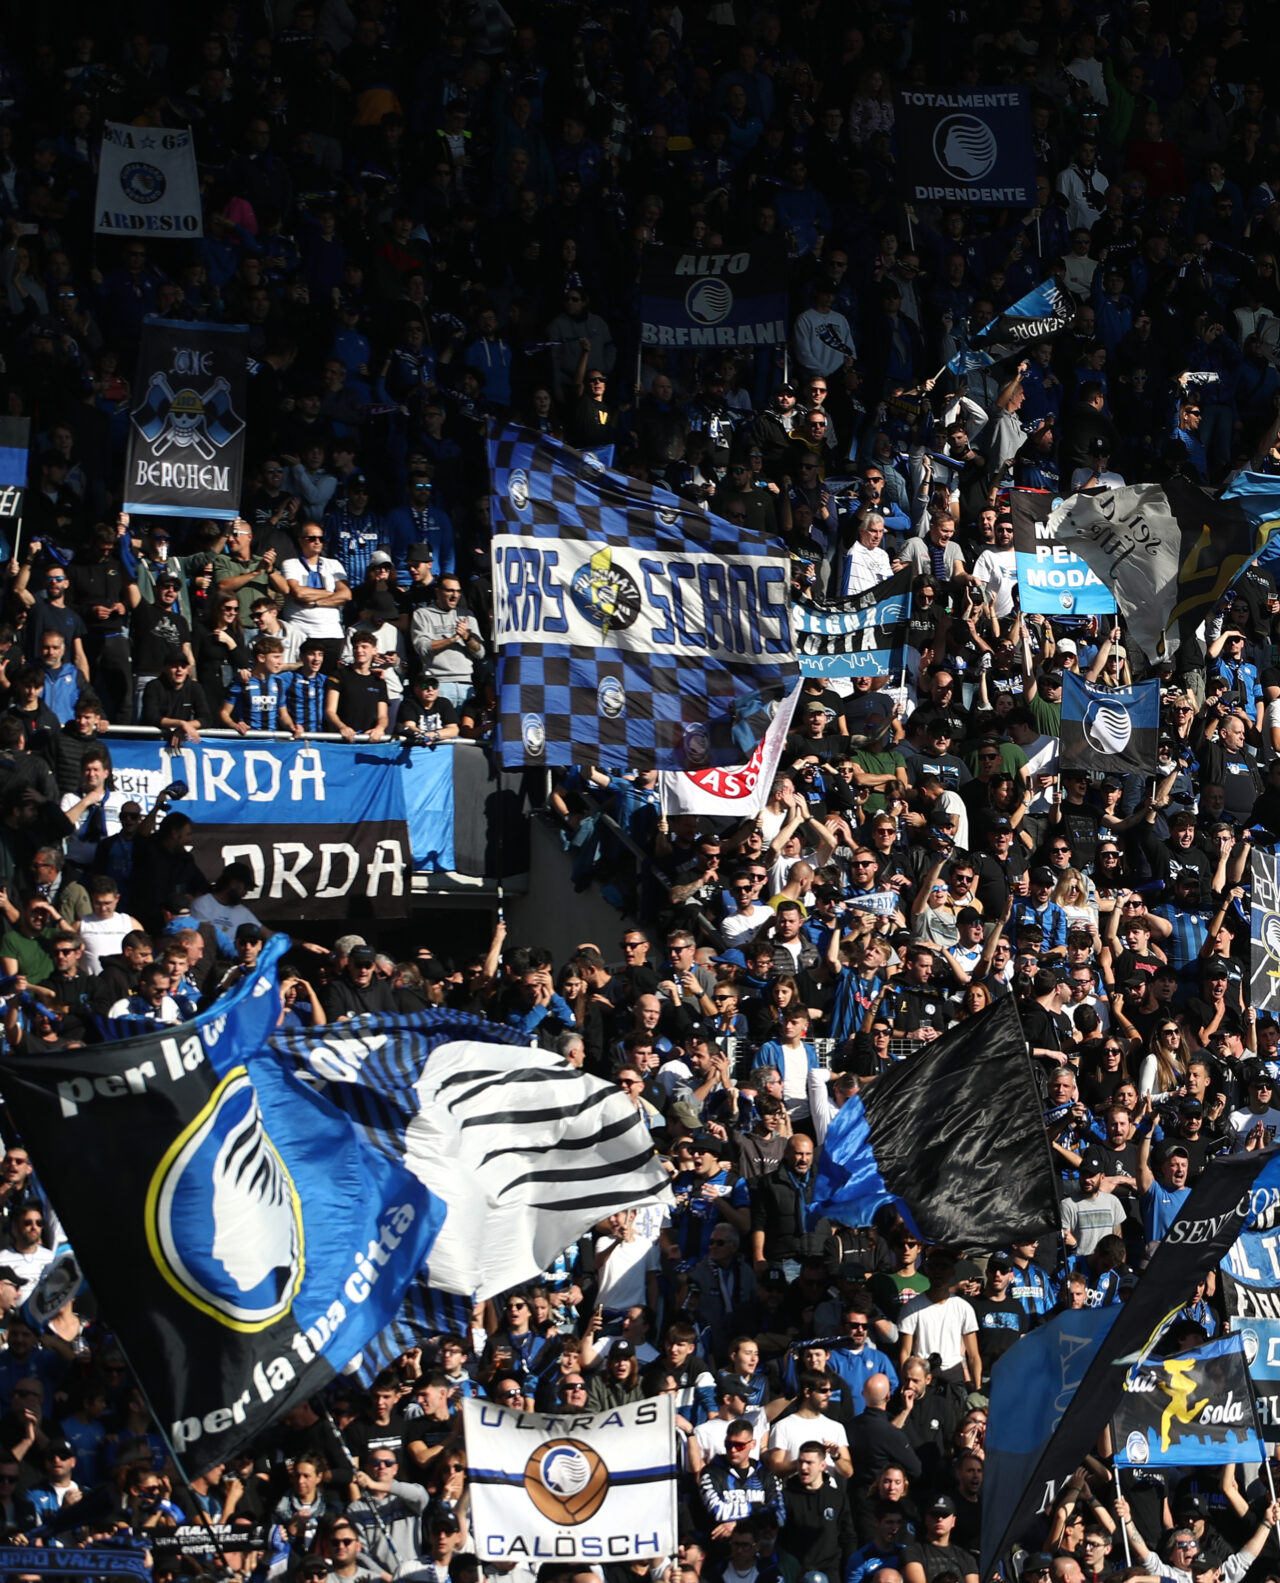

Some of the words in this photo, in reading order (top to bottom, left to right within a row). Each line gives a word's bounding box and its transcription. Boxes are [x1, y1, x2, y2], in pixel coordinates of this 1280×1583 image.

[901, 91, 1020, 107] TOTALMENTE
[162, 132, 189, 150] 65
[915, 186, 1027, 201] DIPENDENTE
[100, 211, 198, 231] ARDESIO
[674, 252, 751, 276] ALTO
[135, 460, 230, 491] BERGHEM
[0, 485, 21, 517] ÉI
[496, 547, 569, 633] RAS
[1026, 568, 1104, 587] MODA
[797, 627, 878, 656] OTTA
[159, 748, 326, 801] ORDA
[183, 840, 406, 899] ORDA
[57, 1060, 157, 1118] per
[160, 1034, 205, 1082] la
[171, 1390, 251, 1454] per
[253, 1356, 296, 1403] la
[291, 1300, 347, 1364] tua
[344, 1203, 416, 1303] città
[480, 1402, 658, 1431] ULTRAS
[1200, 1391, 1244, 1425] sola
[486, 1530, 660, 1557] CALÖSCH
